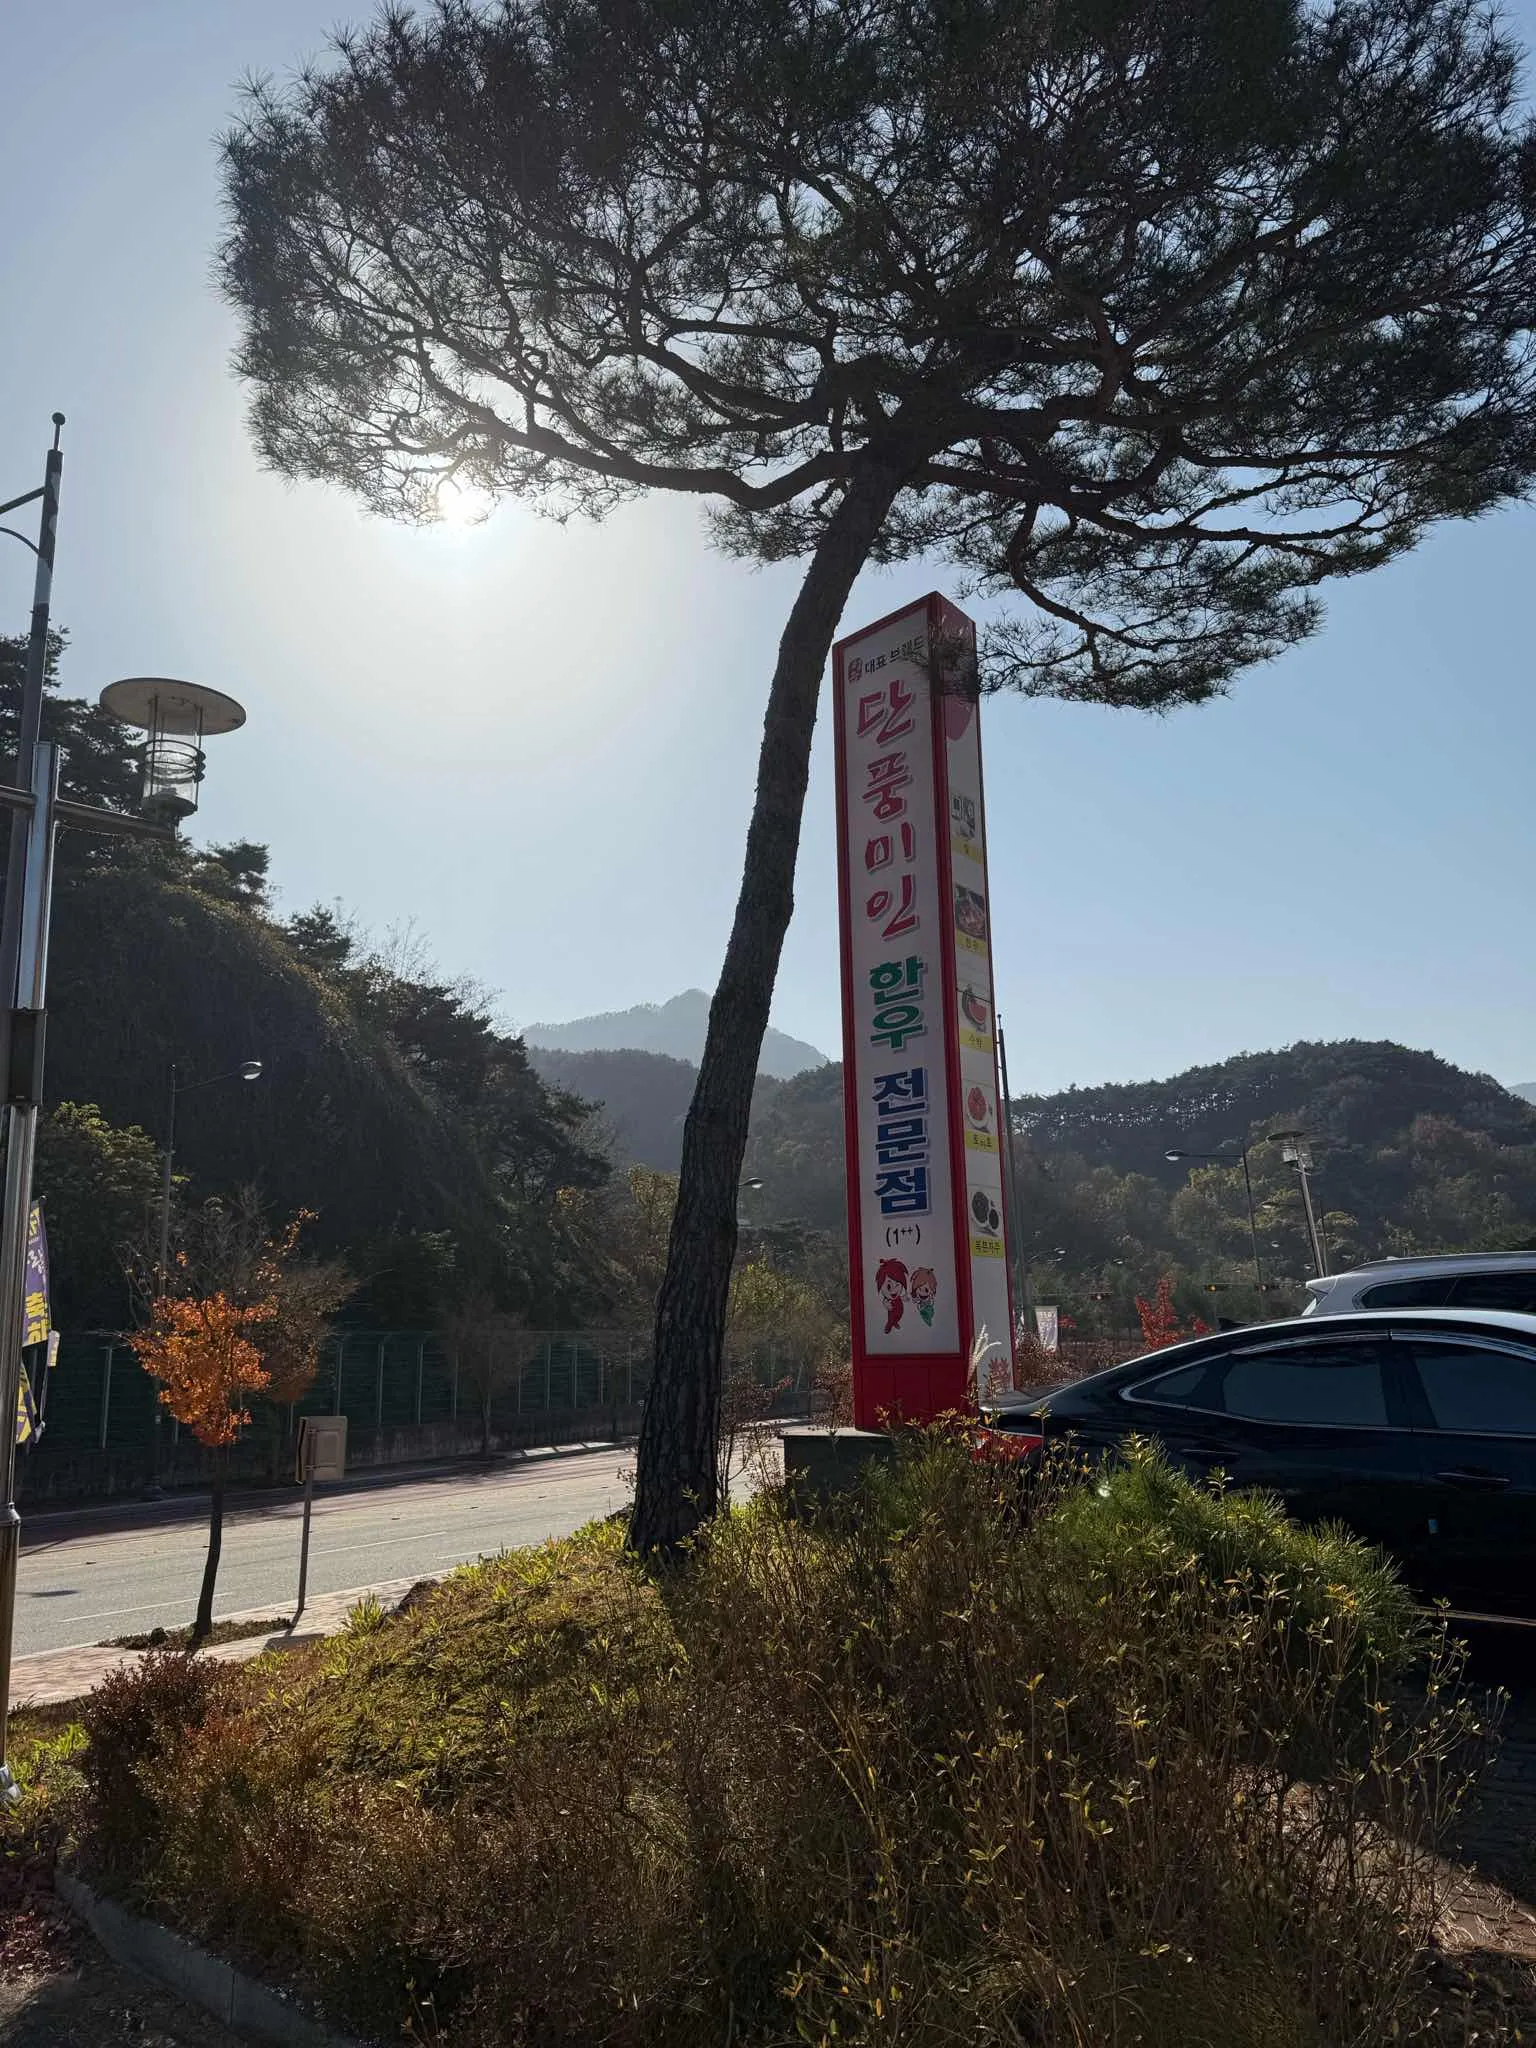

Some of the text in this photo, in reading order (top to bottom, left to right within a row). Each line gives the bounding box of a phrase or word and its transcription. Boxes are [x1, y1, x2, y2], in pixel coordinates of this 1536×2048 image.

[865, 654, 888, 673] 대표
[857, 680, 929, 1215] 단풍미인 한우 전문점
[886, 1224, 921, 1247] (1++)
